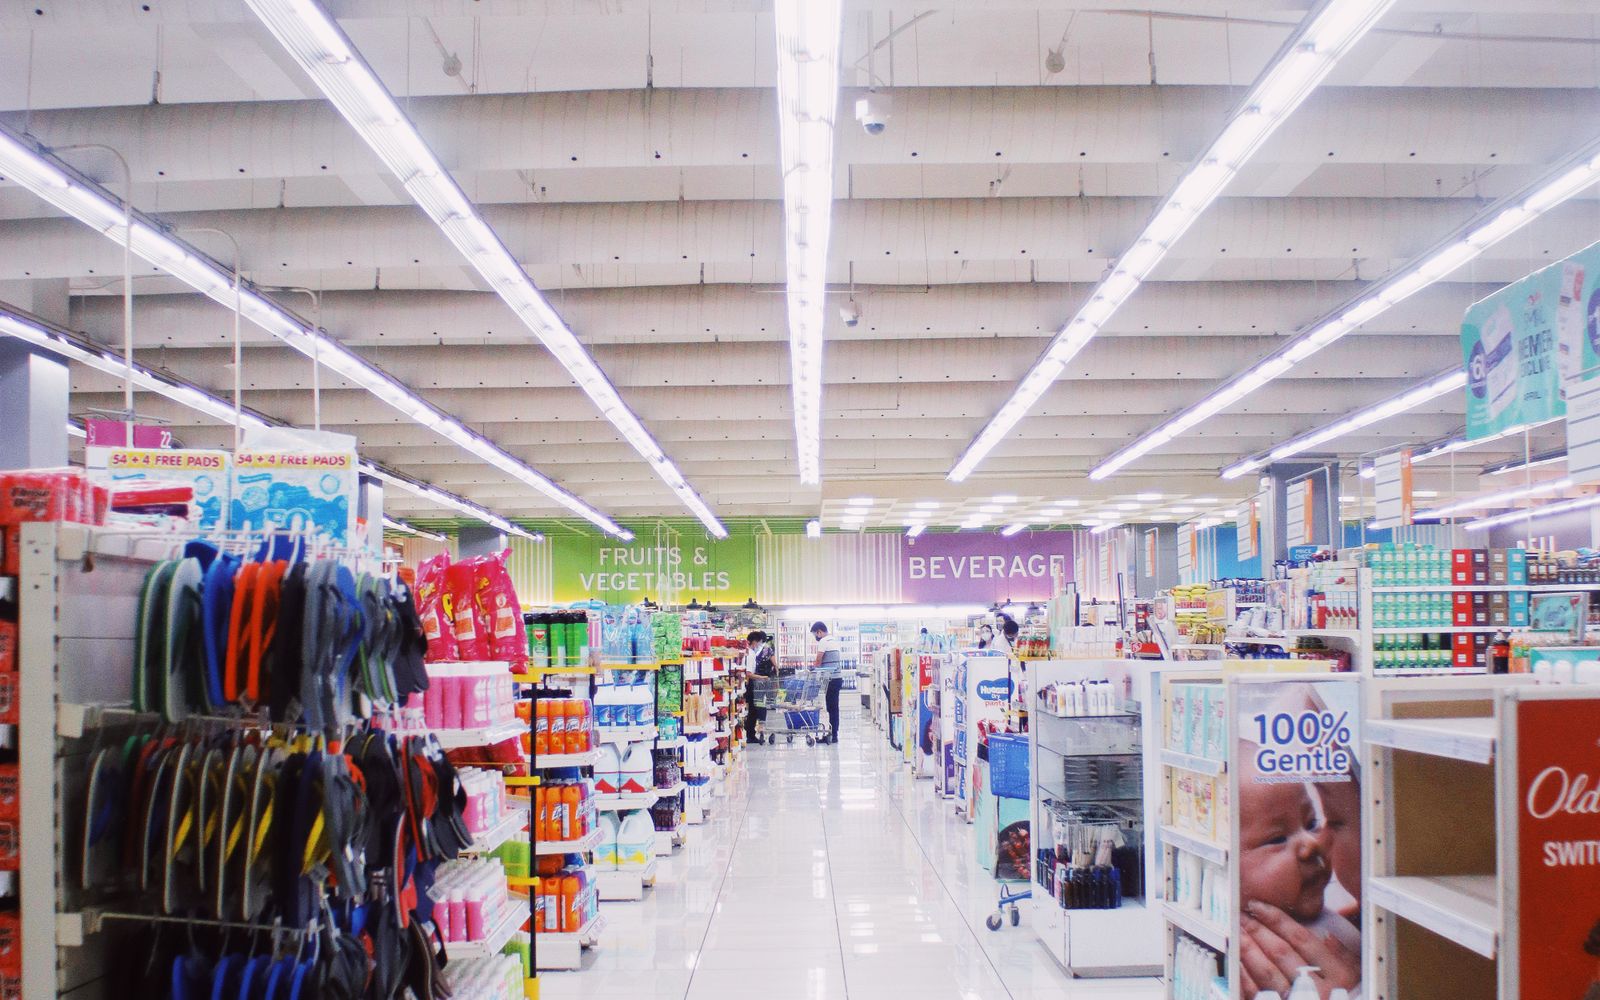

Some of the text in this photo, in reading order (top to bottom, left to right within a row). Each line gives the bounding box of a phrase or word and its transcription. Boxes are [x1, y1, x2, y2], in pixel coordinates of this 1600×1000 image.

[160, 430, 172, 449] 22
[112, 454, 127, 465] 54
[142, 455, 150, 465] 4
[154, 455, 182, 466] FREE
[186, 456, 220, 467] PADS
[237, 454, 346, 466] 54 + 4 FREE PADS
[599, 547, 708, 565] FRUITS &
[909, 554, 1065, 579] BEVERAGE
[579, 571, 730, 591] VEGETABLES
[1253, 711, 1350, 745] 100%
[1256, 747, 1348, 772] Gentle
[1543, 840, 1600, 867] SWIT
